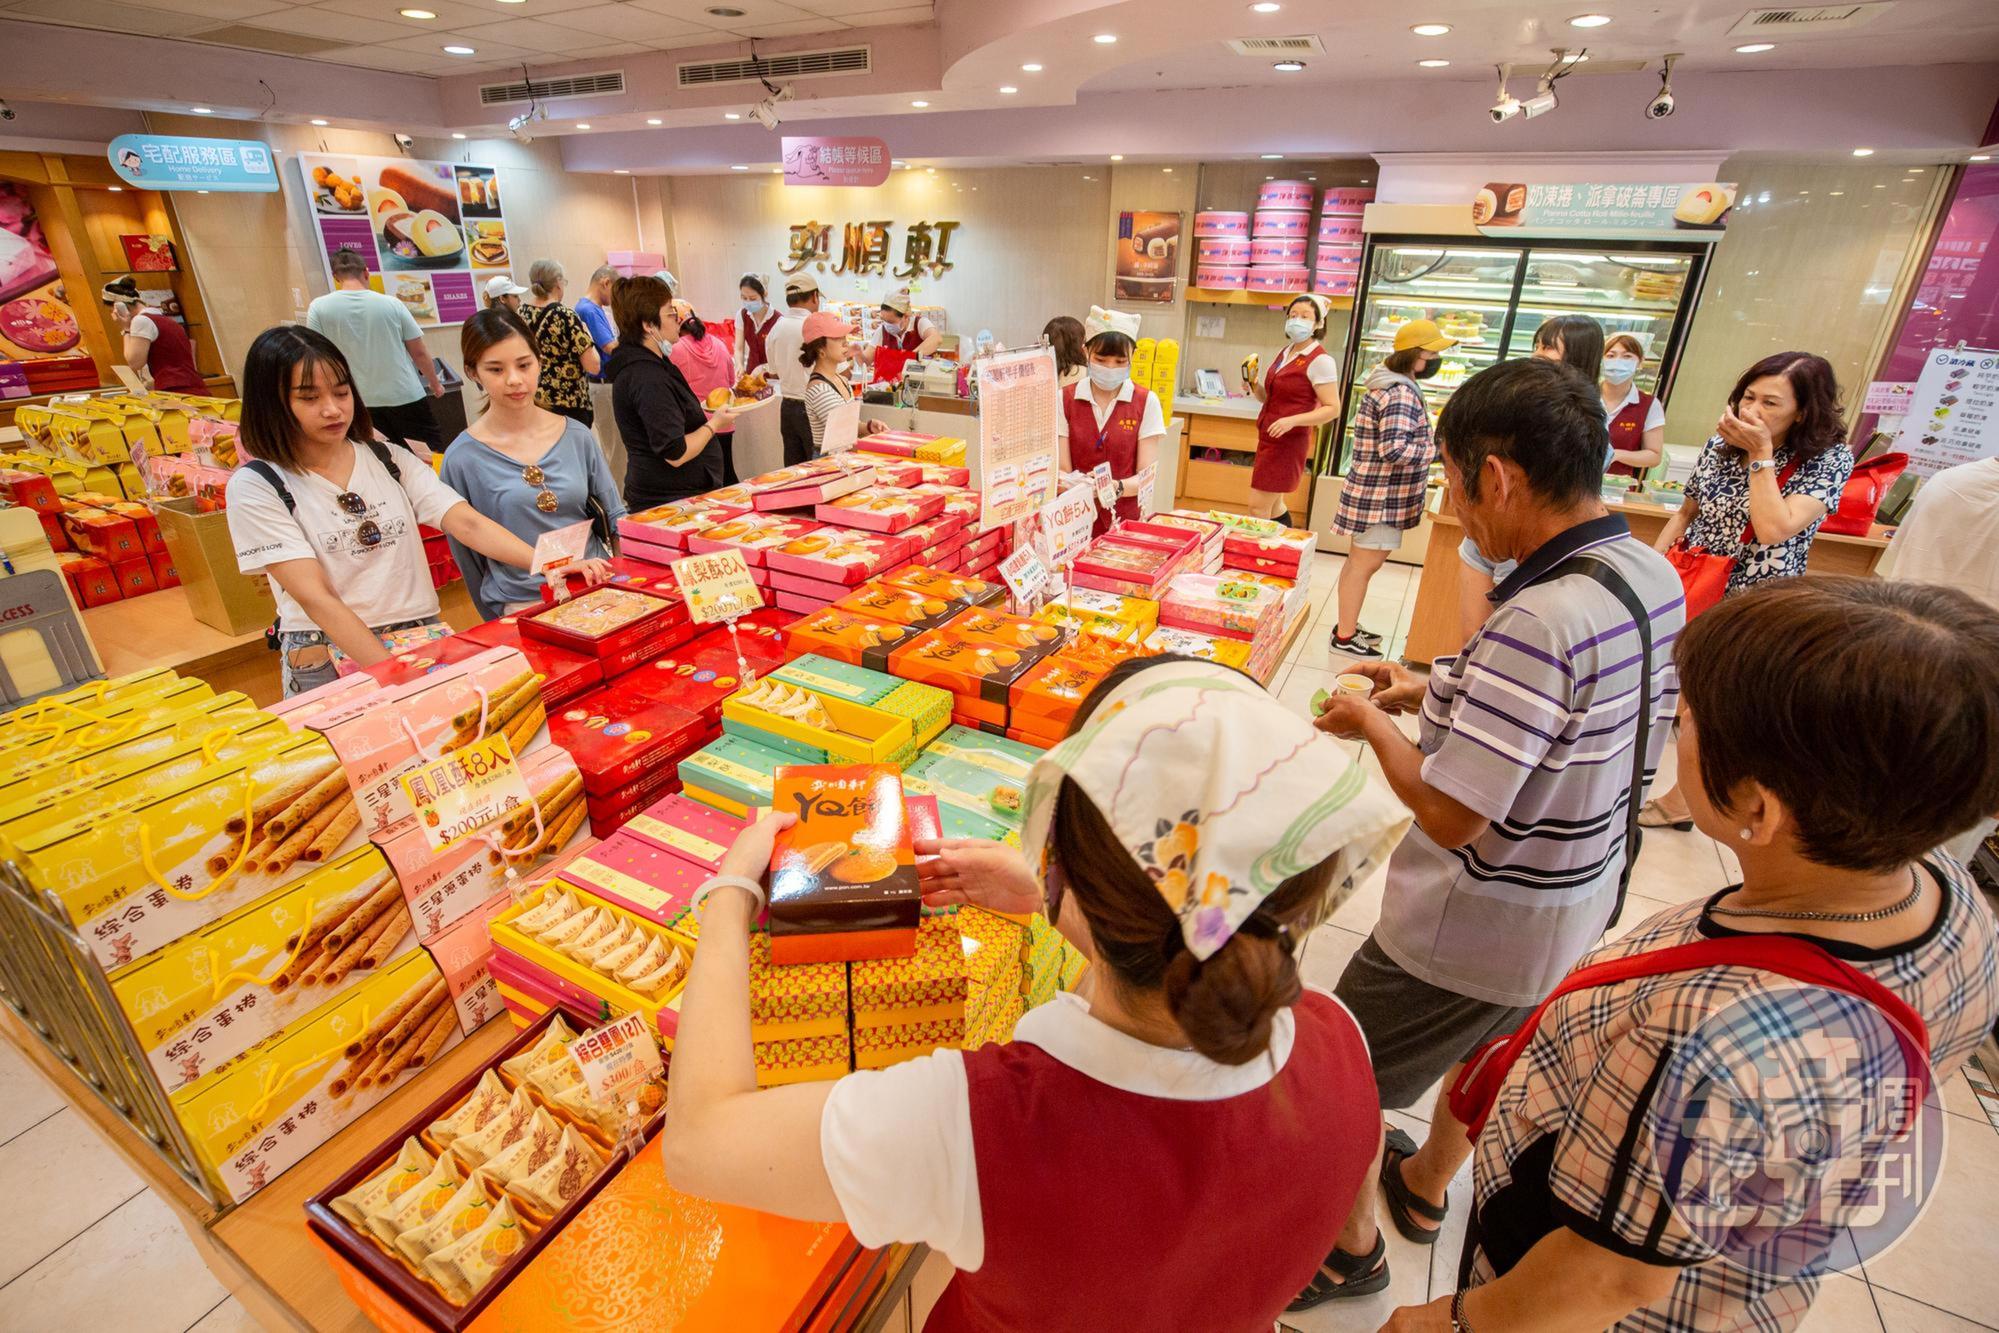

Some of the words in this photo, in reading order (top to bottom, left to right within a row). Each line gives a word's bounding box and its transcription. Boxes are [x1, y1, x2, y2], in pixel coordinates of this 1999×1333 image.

[142, 144, 239, 166] 宅配服務區
[169, 165, 190, 174] Home
[192, 166, 222, 175] Delivery
[820, 146, 882, 164] 結帳等候區
[267, 542, 283, 551] LOVE
[0, 604, 34, 623] CESS
[408, 747, 510, 808] 鳳凰酥8入
[439, 795, 521, 845] $200元/盒
[94, 874, 193, 941] 綜合蛋捲
[418, 861, 483, 916] 三星蔥蛋捲
[165, 993, 258, 1062] 綜合蛋捲
[235, 1100, 318, 1173] 綜合蛋捲
